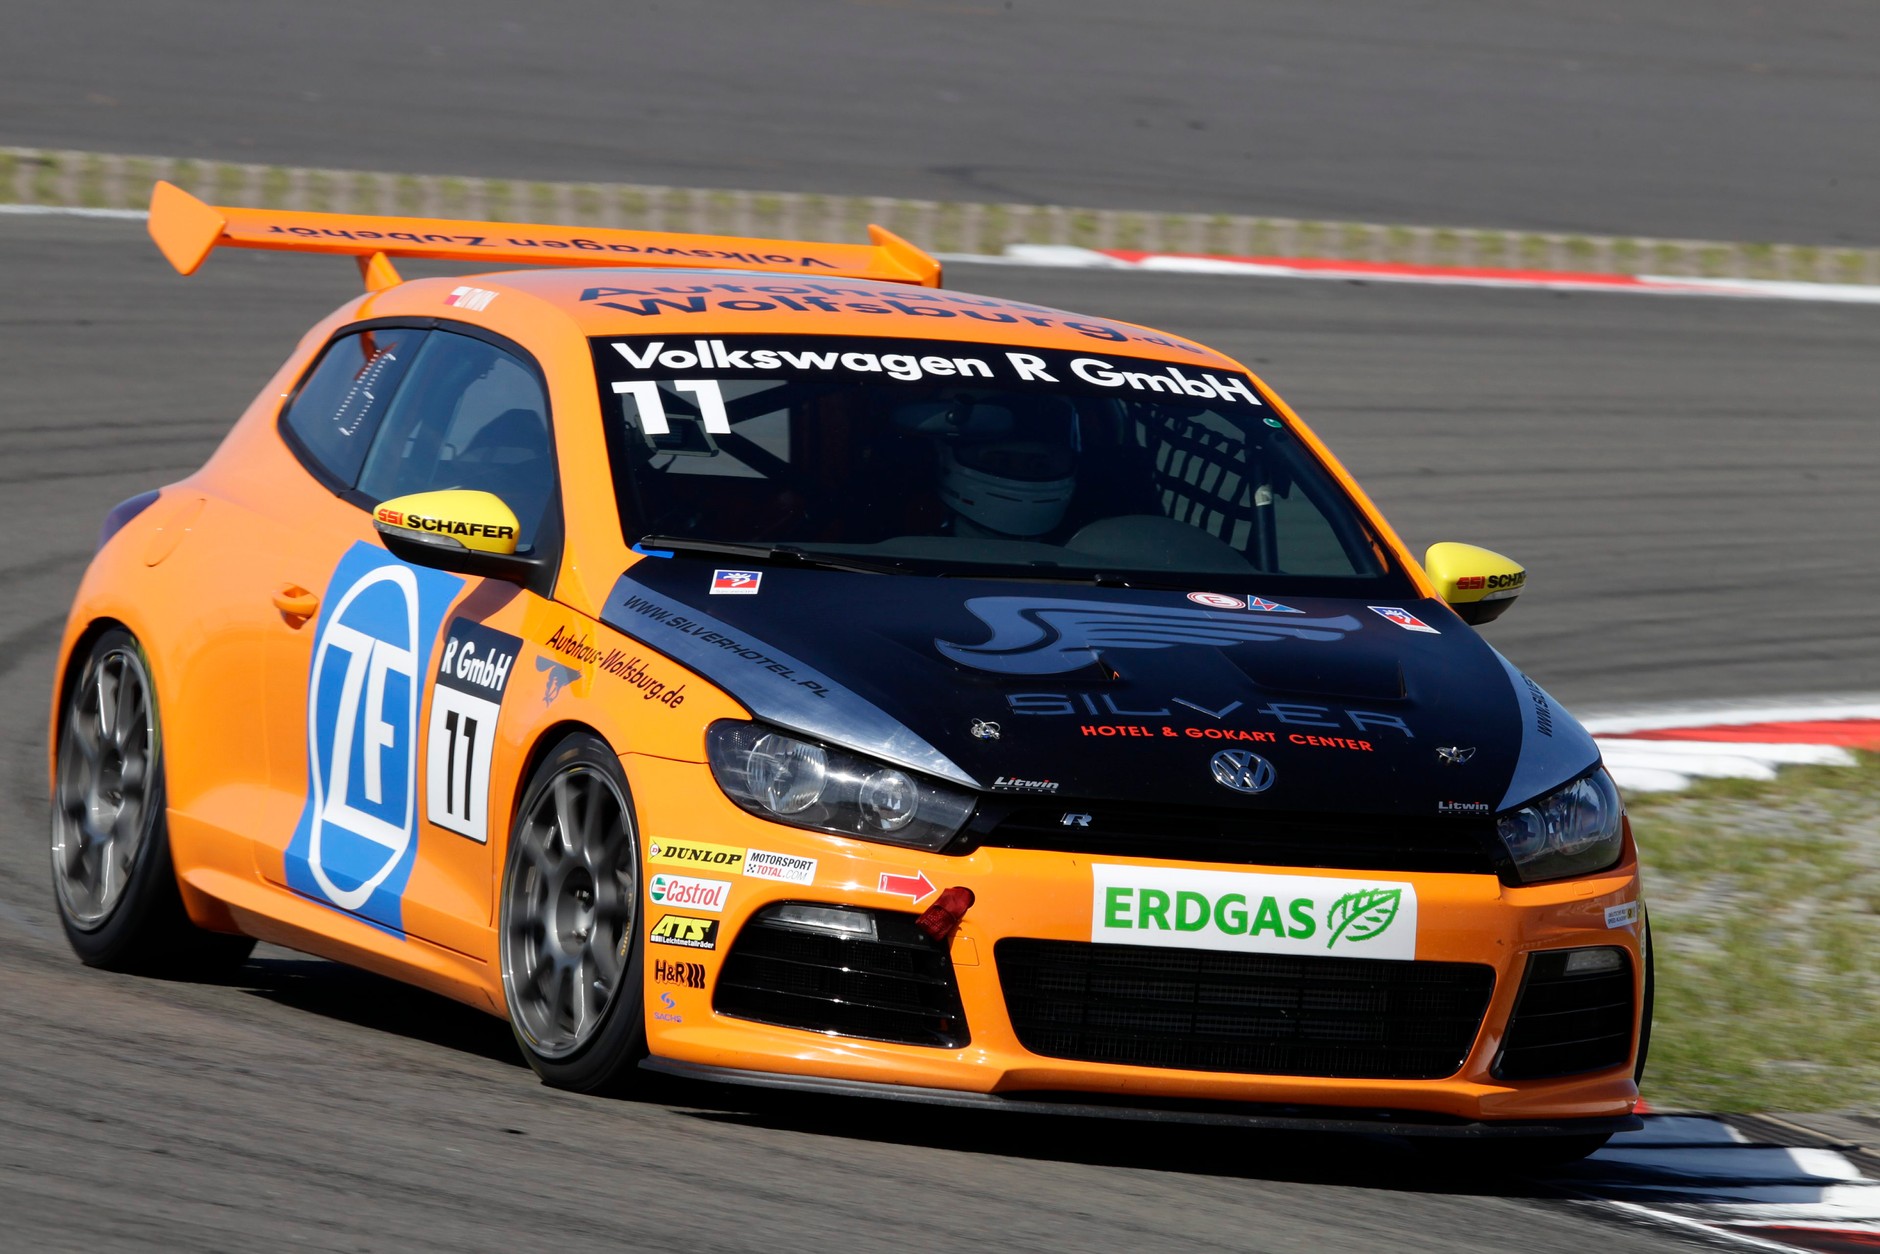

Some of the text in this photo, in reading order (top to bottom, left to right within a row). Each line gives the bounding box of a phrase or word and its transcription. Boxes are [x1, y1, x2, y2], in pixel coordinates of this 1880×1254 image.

[267, 224, 839, 269] Volkswagen Zubehör
[595, 294, 1204, 355] Wolfsburg.de
[610, 339, 1263, 407] Volkswagen R GmbH
[610, 379, 732, 435] 11
[378, 508, 514, 540] SSI SCHÄFER
[1456, 575, 1486, 590] SSI
[624, 593, 834, 699] WWW.SILVERHOTEL.PL
[440, 636, 513, 692] R GmbH
[545, 624, 686, 709] Autohaus-Wolfsburg.de
[1004, 692, 1416, 739] SILVER
[1080, 725, 1375, 752] HOTEL & GOKART CENTER
[444, 708, 478, 832] 11
[993, 776, 1060, 790] Litwin
[1059, 811, 1093, 828] R
[1438, 800, 1490, 811] Litwin
[662, 845, 743, 866] DUNLOP
[750, 851, 814, 871] MOTORSPORT
[756, 864, 808, 882] TOTAL.COM
[666, 879, 723, 907] Castrol
[1104, 886, 1317, 940] ERDGAS
[651, 914, 713, 942] ATS
[655, 958, 687, 986] H&R
[654, 1010, 683, 1024] SACHS
